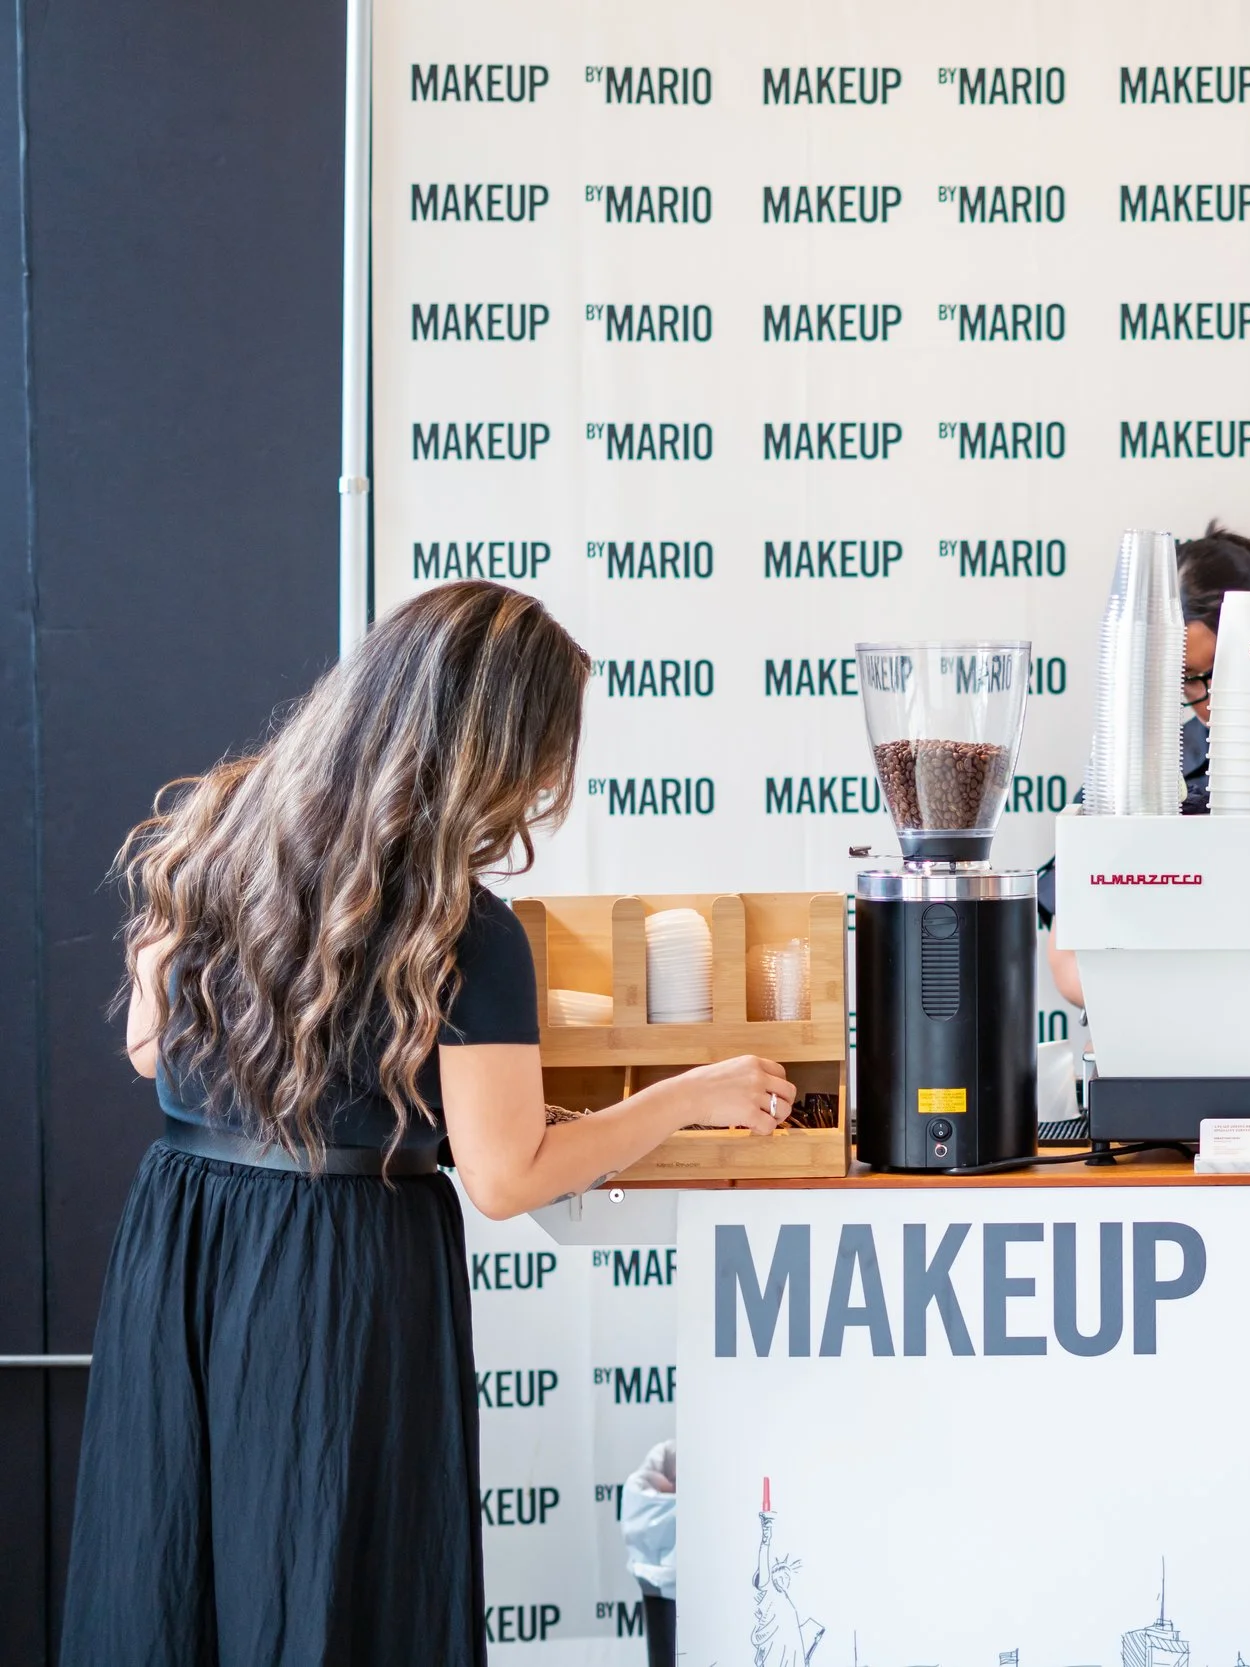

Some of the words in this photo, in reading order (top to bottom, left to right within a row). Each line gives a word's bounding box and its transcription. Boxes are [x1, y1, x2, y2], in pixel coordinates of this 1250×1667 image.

[411, 63, 549, 103] MAKEUP
[585, 66, 605, 83] BY
[606, 66, 712, 105] MARIO
[763, 66, 902, 105] MAKEUP
[938, 67, 958, 84] BY
[959, 66, 1065, 105] MARIO
[411, 183, 549, 222] MAKEUP
[585, 185, 605, 202] BY
[606, 185, 712, 224] MARIO
[763, 185, 902, 224] MAKEUP
[938, 185, 958, 202] BY
[959, 185, 1065, 223] MARIO
[412, 303, 550, 341] MAKEUP
[586, 304, 606, 321] BY
[606, 304, 712, 342] MARIO
[763, 304, 902, 342] MAKEUP
[939, 304, 959, 321] BY
[959, 303, 1065, 341] MARIO
[412, 422, 550, 460] MAKEUP
[586, 423, 606, 440] BY
[607, 422, 713, 461] MARIO
[764, 422, 903, 460] MAKEUP
[939, 422, 959, 439] BY
[959, 421, 1065, 459] MARIO
[413, 541, 551, 579] MAKEUP
[587, 541, 607, 558] BY
[607, 541, 713, 579] MARIO
[764, 540, 903, 578] MAKEUP
[939, 540, 959, 557] BY
[960, 539, 1066, 577] MARIO
[608, 659, 714, 697] MARIO
[765, 658, 859, 697] MAKE
[588, 779, 608, 796] BY
[609, 777, 715, 816] MARIO
[765, 776, 884, 814] MAKEU
[472, 1251, 557, 1291] KEUP
[593, 1250, 611, 1267] BY
[714, 1221, 1207, 1358] MAKEUP
[477, 1369, 559, 1409] KEUP
[593, 1367, 612, 1385] BY
[594, 1484, 613, 1503] BY
[595, 1601, 615, 1620] BY
